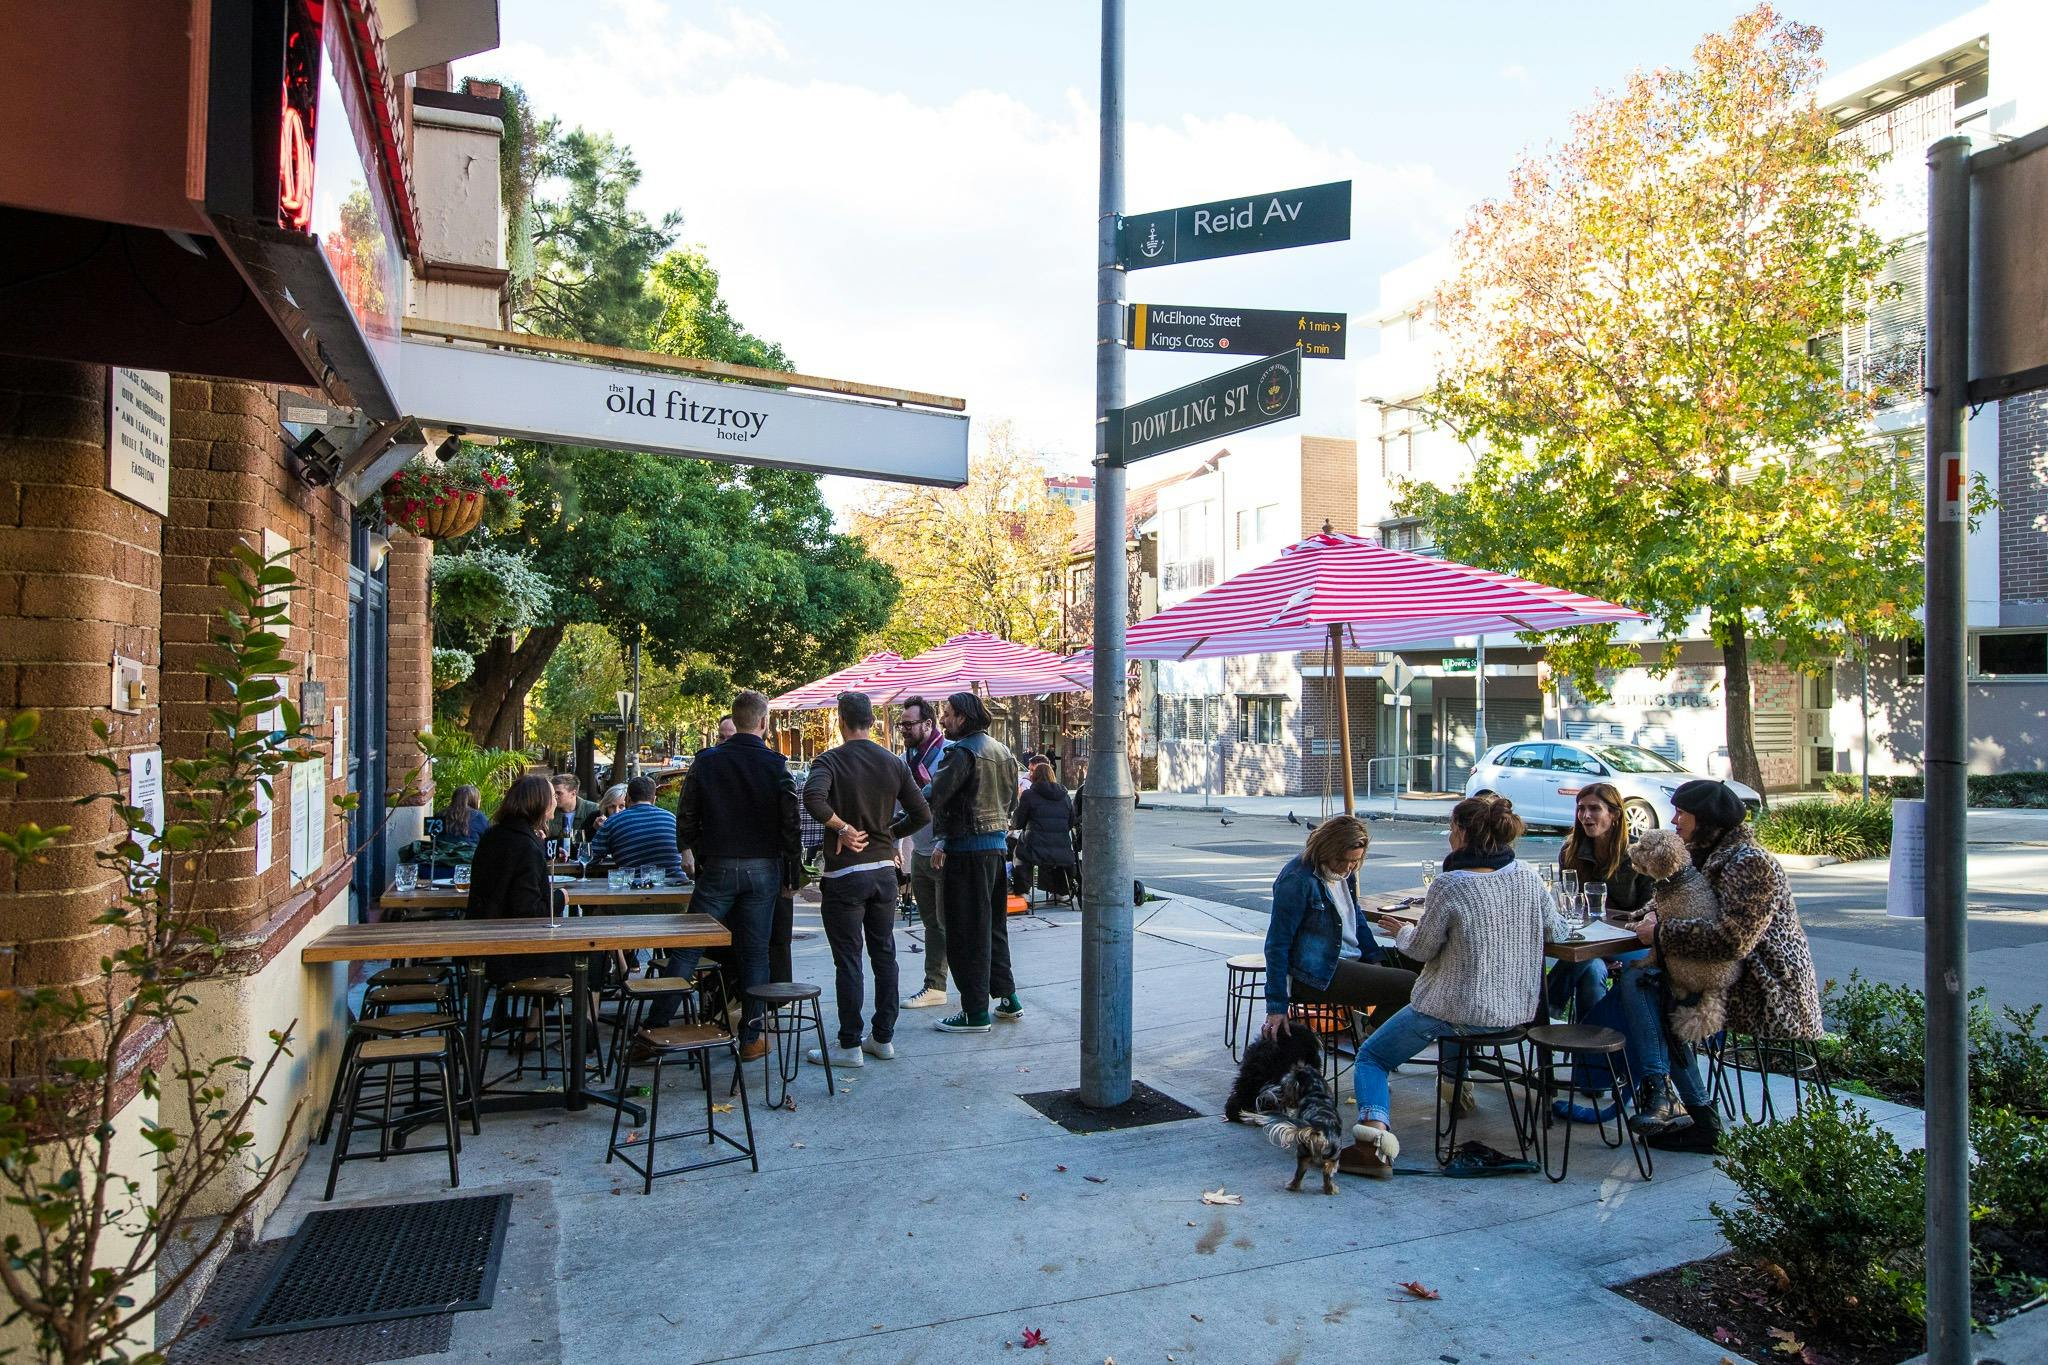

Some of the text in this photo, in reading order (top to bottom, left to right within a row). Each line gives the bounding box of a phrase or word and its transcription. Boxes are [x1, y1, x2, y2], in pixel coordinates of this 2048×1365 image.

[1194, 198, 1303, 236] Reid Av
[1152, 311, 1331, 332] McElhone Street 1 min
[1151, 333, 1182, 349] Kings
[1184, 335, 1214, 348] Cross
[1306, 343, 1312, 353] 5
[1313, 344, 1330, 354] min
[121, 388, 134, 404] OUR
[609, 384, 624, 393] the
[606, 386, 769, 438] old fitzroy
[1131, 384, 1249, 446] DOWLING ST
[121, 411, 164, 447] AND LEAVE IN A
[717, 428, 748, 442] hotel
[131, 461, 155, 484] FASHION
[426, 819, 443, 834] 73
[546, 839, 558, 858] 87
